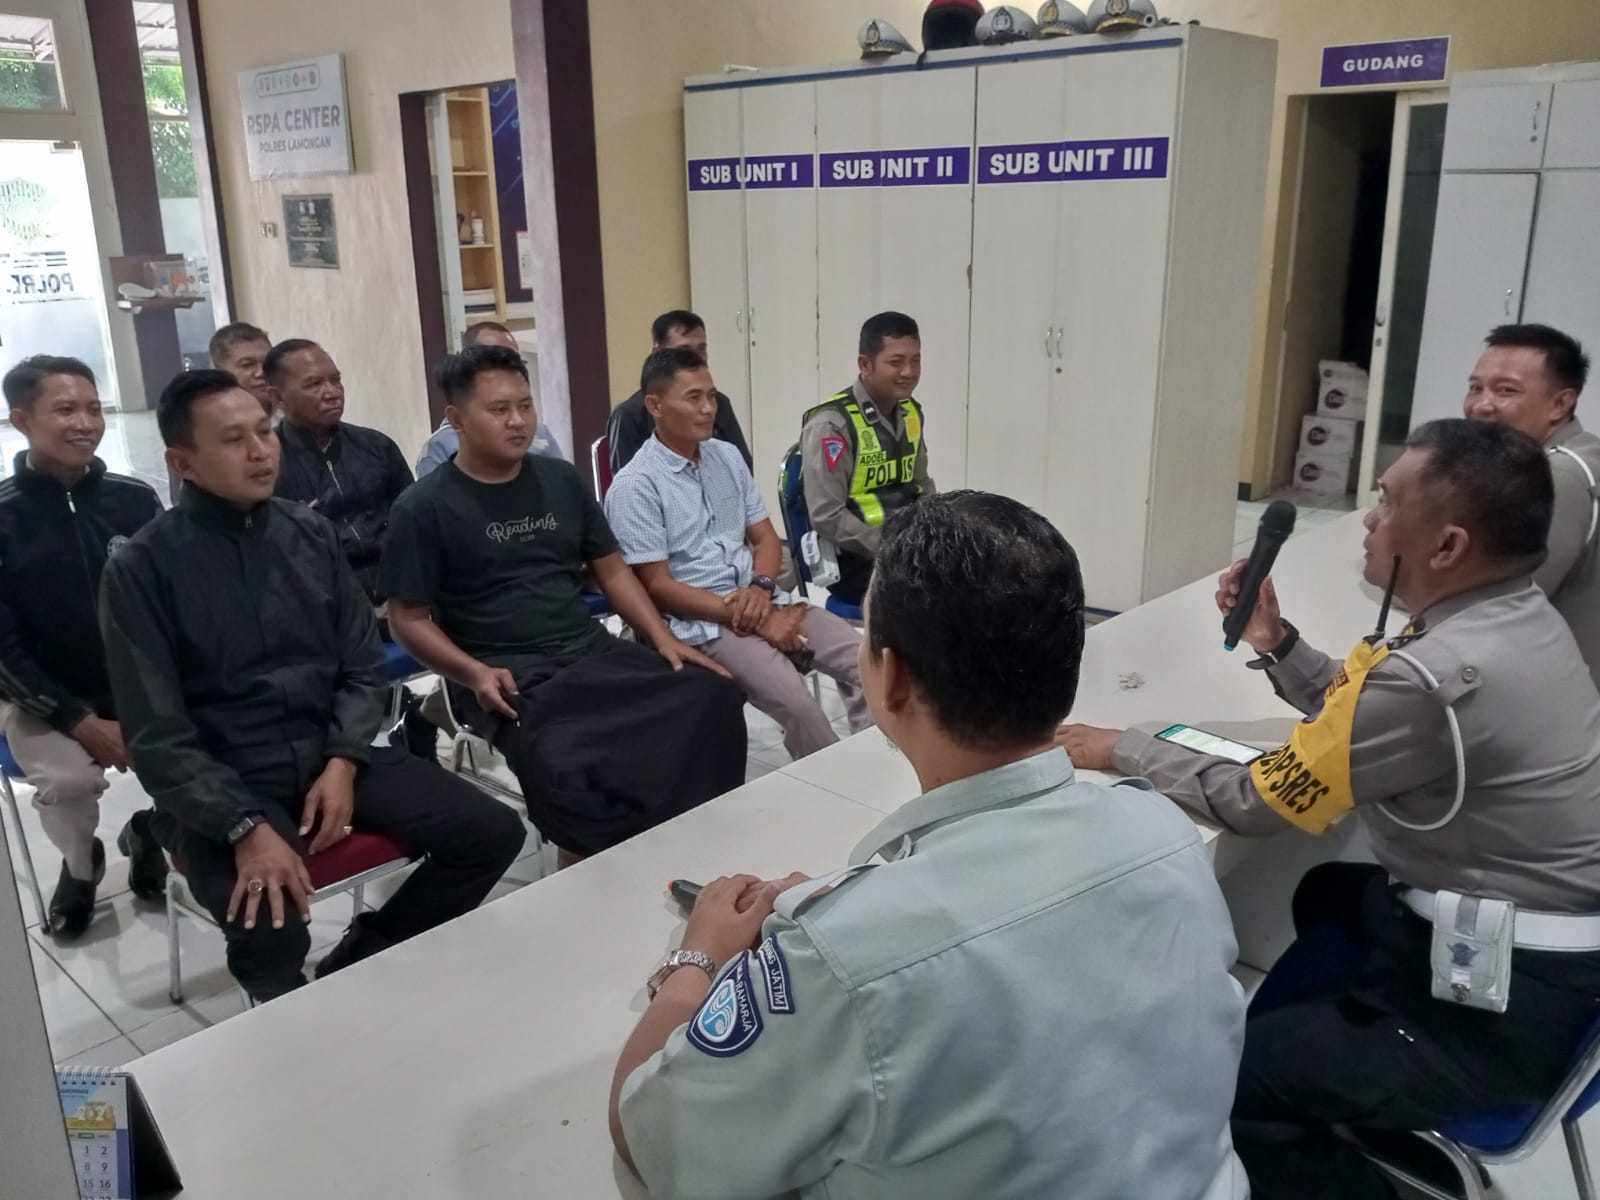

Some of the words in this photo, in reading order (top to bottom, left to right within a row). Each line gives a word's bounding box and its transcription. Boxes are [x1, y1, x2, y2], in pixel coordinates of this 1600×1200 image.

[1342, 54, 1424, 73] GUDANG
[246, 112, 282, 136] RSPA
[284, 104, 341, 132] CENTER
[259, 140, 287, 153] POLRES
[288, 136, 331, 151] LAMONGAN
[832, 159, 874, 180] SUB
[936, 156, 953, 177] II
[989, 152, 1040, 176] SUB
[1048, 148, 1115, 173] UNIT
[1123, 146, 1153, 170] III
[700, 164, 732, 184] SUB
[735, 162, 786, 183] UNIT
[791, 162, 798, 181] I
[486, 512, 559, 543] Reading
[771, 969, 785, 1005] JATIM
[735, 980, 753, 1032] RAHARJA
[84, 1145, 89, 1155] 1
[101, 1145, 107, 1155] 2
[102, 1162, 108, 1171] 9
[83, 1179, 95, 1189] 15
[99, 1179, 111, 1189] 16
